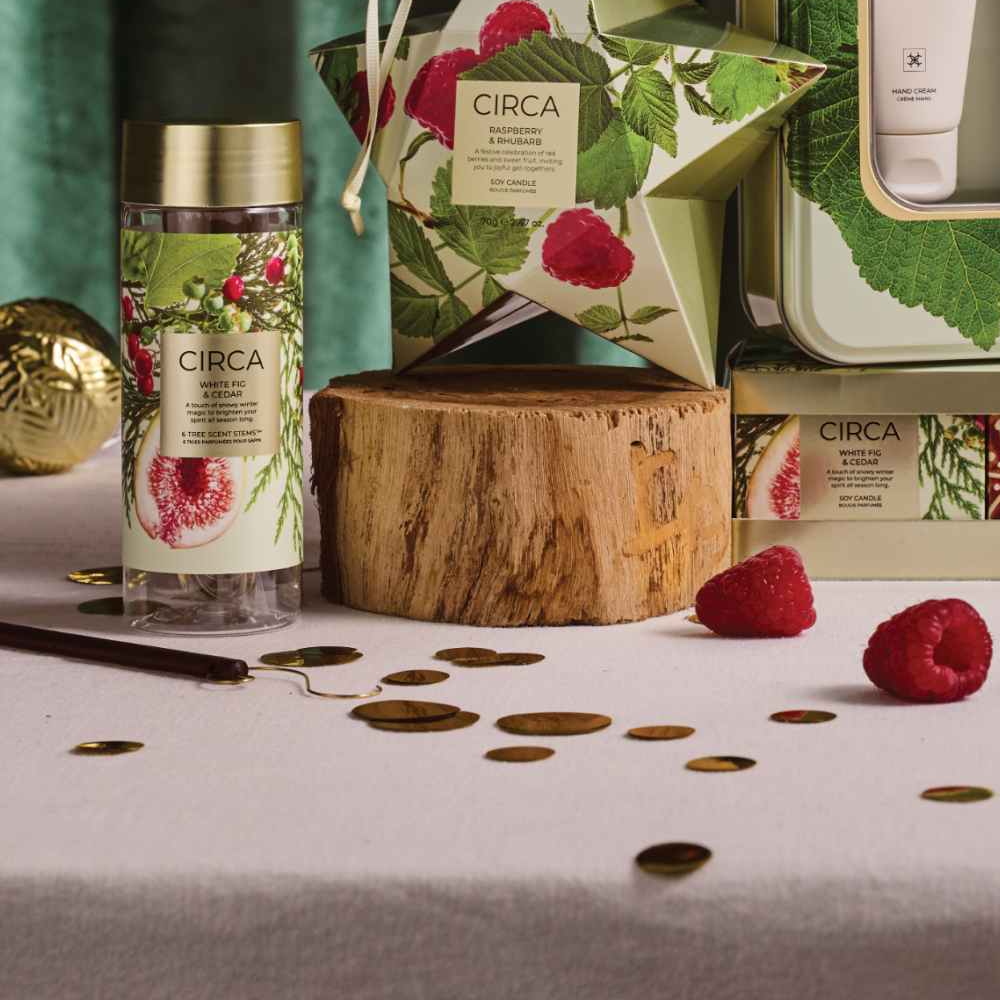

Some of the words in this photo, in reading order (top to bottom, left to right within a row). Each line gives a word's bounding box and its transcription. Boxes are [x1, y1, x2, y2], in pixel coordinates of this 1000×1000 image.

[473, 93, 560, 117] CIRCA
[489, 126, 543, 135] RASPBERRY
[497, 137, 542, 146] RHUBARB
[539, 158, 563, 166] inviting
[511, 165, 556, 173] get-togethers.
[506, 179, 536, 187] CANDLE
[179, 349, 264, 372] CIRCA
[200, 381, 229, 389] WHITE
[203, 391, 209, 399] &
[211, 391, 243, 399] CEDAR
[820, 421, 901, 441] CIRCA
[838, 449, 866, 457] WHITE
[868, 449, 882, 457] FIG
